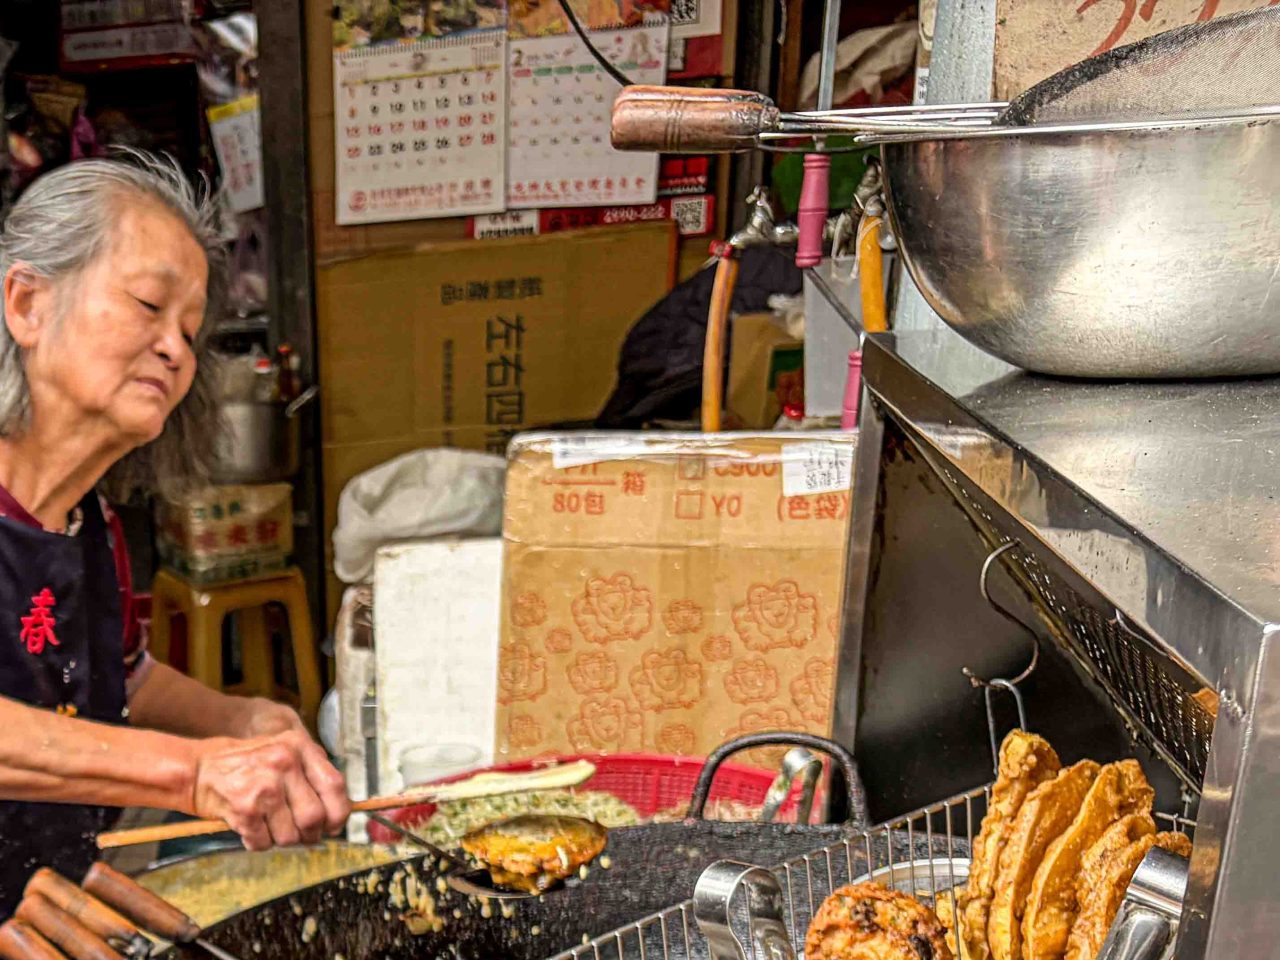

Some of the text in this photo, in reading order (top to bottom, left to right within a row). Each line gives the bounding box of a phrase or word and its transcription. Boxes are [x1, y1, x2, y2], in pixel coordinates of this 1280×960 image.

[623, 470, 645, 496] 箱
[552, 489, 605, 515] 80包
[20, 586, 60, 655] 春
